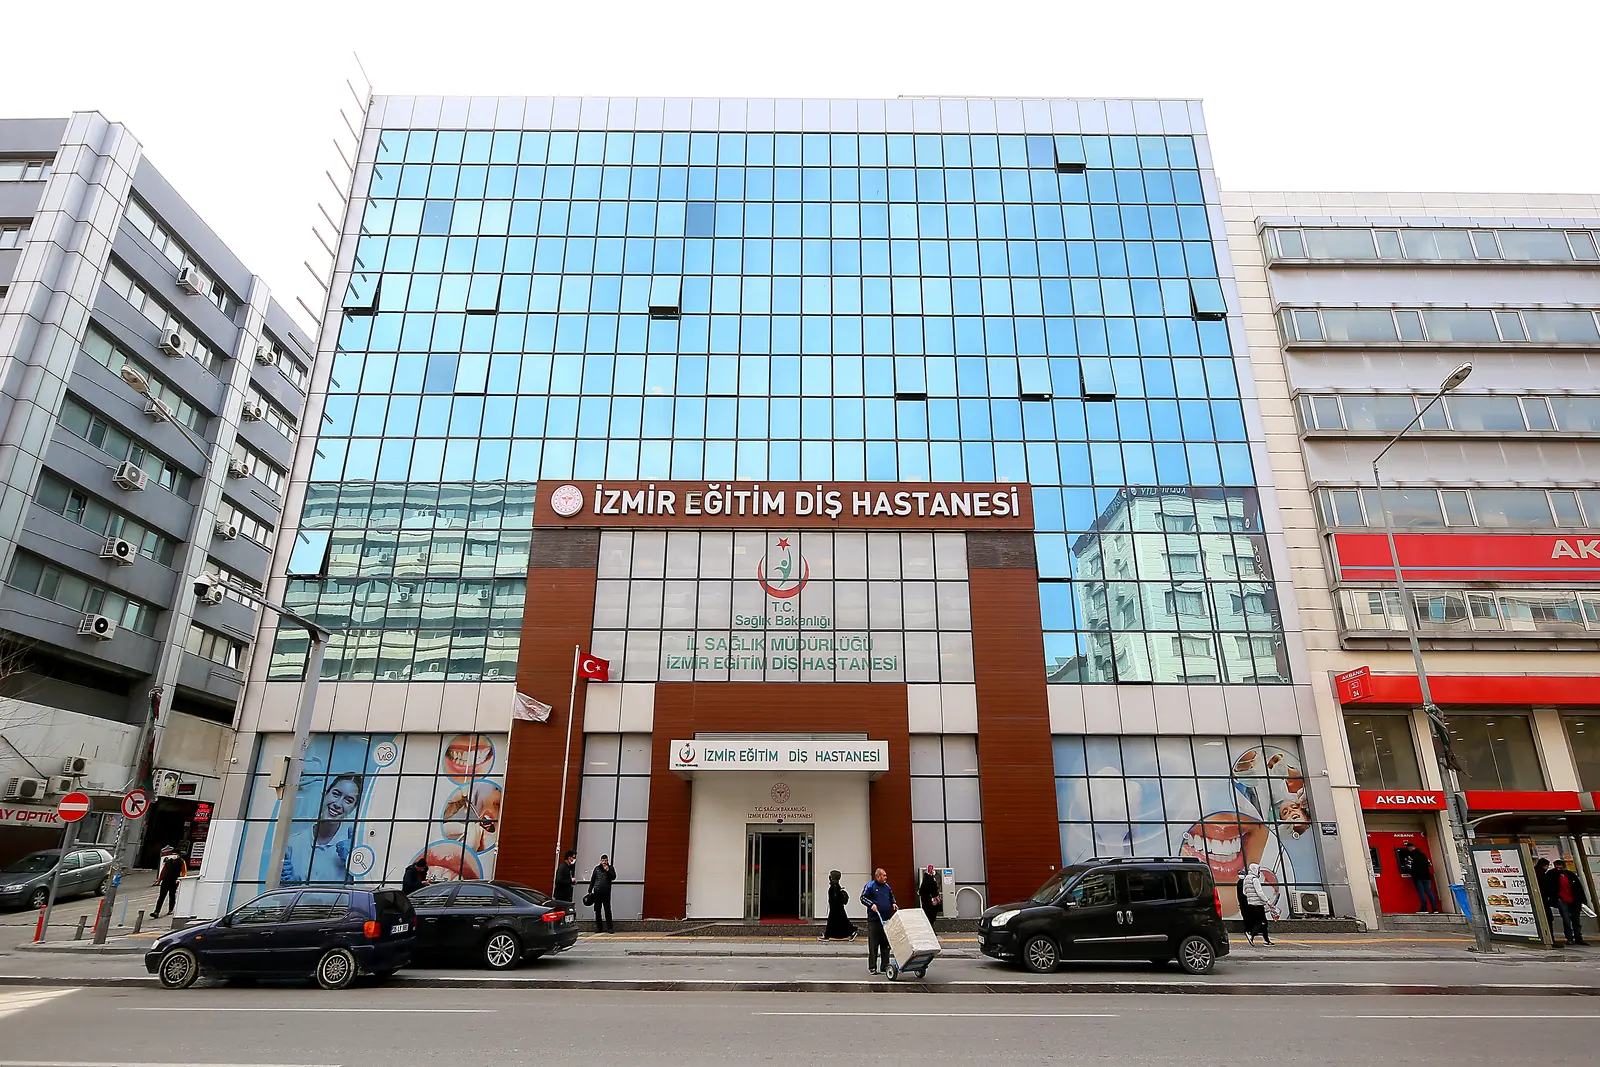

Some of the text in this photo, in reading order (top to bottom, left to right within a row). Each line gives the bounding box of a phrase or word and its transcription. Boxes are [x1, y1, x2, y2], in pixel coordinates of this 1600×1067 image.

[594, 484, 1020, 519] İZMİR EĞİTİM DİŞ HASTANESİ
[1551, 539, 1600, 559] AK
[771, 601, 795, 612] T.C.
[735, 615, 830, 629] Sağlık Bakanlığı
[686, 635, 874, 651] İL SAĞLIK MÜDÜRLÜĞÜ
[666, 654, 898, 673] İZMİR EĞİTİM DİŞ HASTANESİ
[1341, 669, 1364, 680] AKBANK
[704, 747, 881, 764] İZMİR EĞİTİM DİŞ HASTANESİ
[1376, 795, 1437, 804] AKBANK
[16, 809, 58, 823] OPTİK
